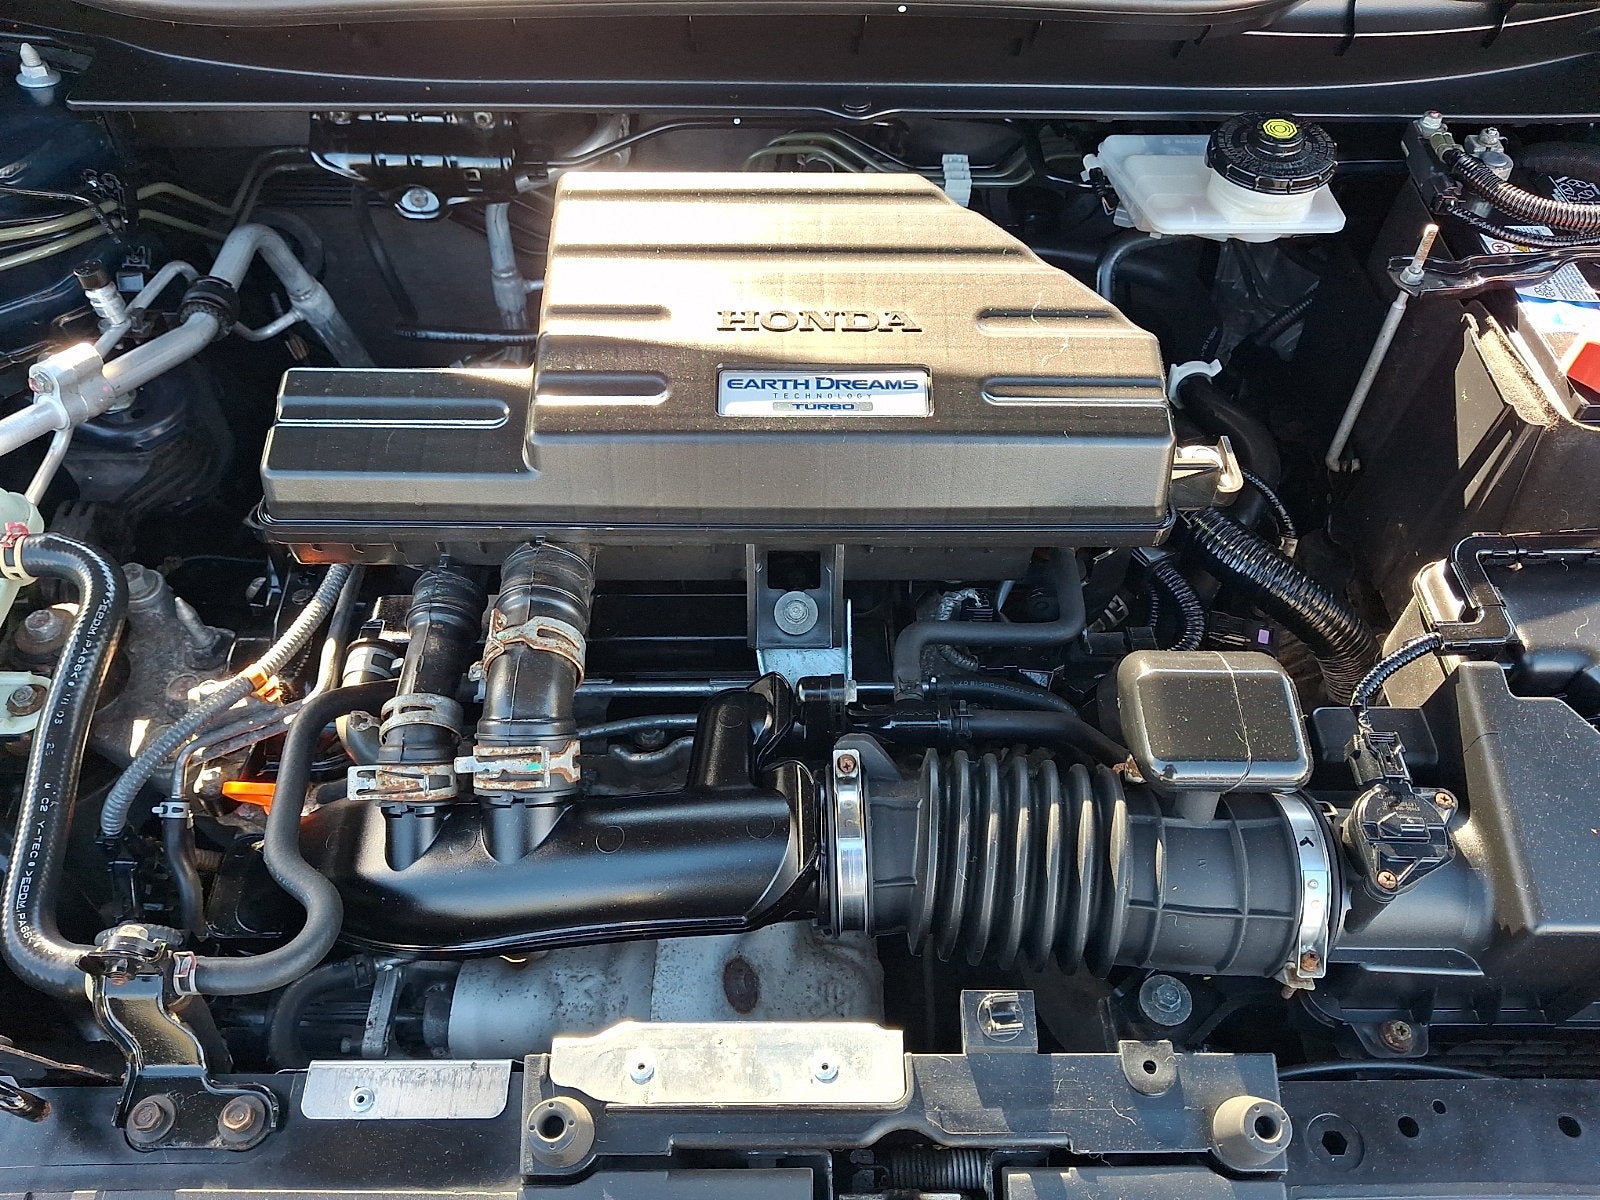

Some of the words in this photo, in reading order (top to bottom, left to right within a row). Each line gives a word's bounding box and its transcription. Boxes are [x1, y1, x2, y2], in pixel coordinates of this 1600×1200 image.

[716, 310, 923, 332] HONDA
[727, 378, 810, 390] EARTH
[815, 376, 919, 390] DREAMS
[773, 392, 873, 400] TECHNOLOGY
[792, 403, 855, 411] TURBO
